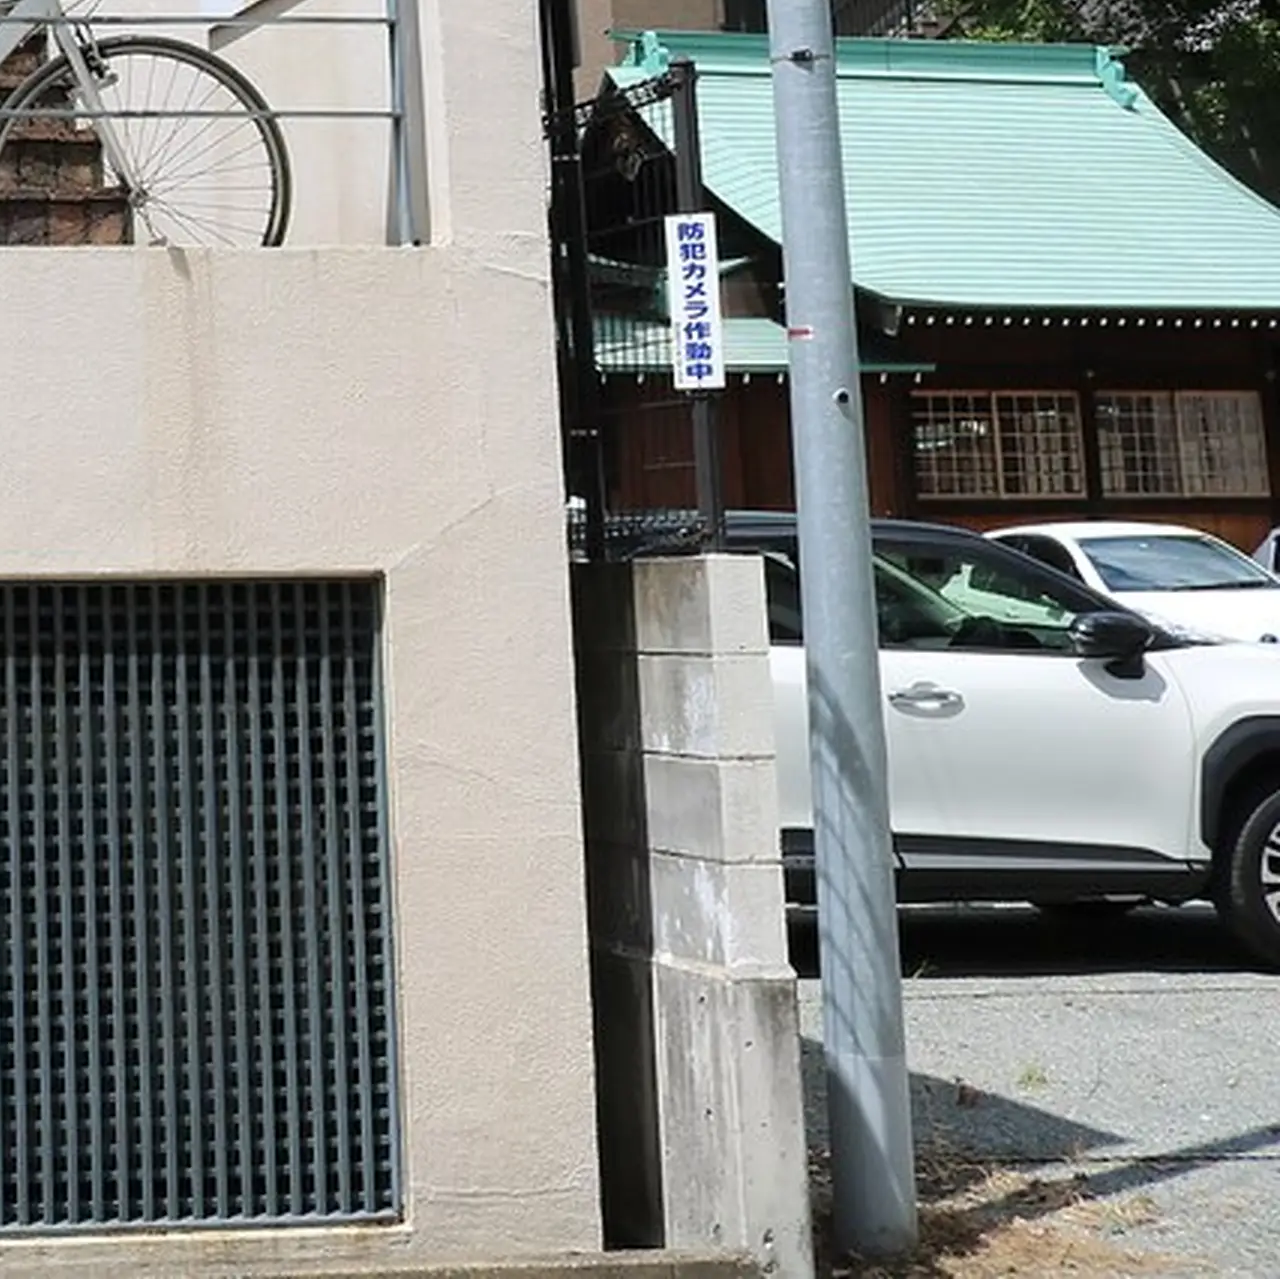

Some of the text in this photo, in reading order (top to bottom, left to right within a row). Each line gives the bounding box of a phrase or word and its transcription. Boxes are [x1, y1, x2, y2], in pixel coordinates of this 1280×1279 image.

[676, 221, 714, 381] 防犯カメラ作動中
